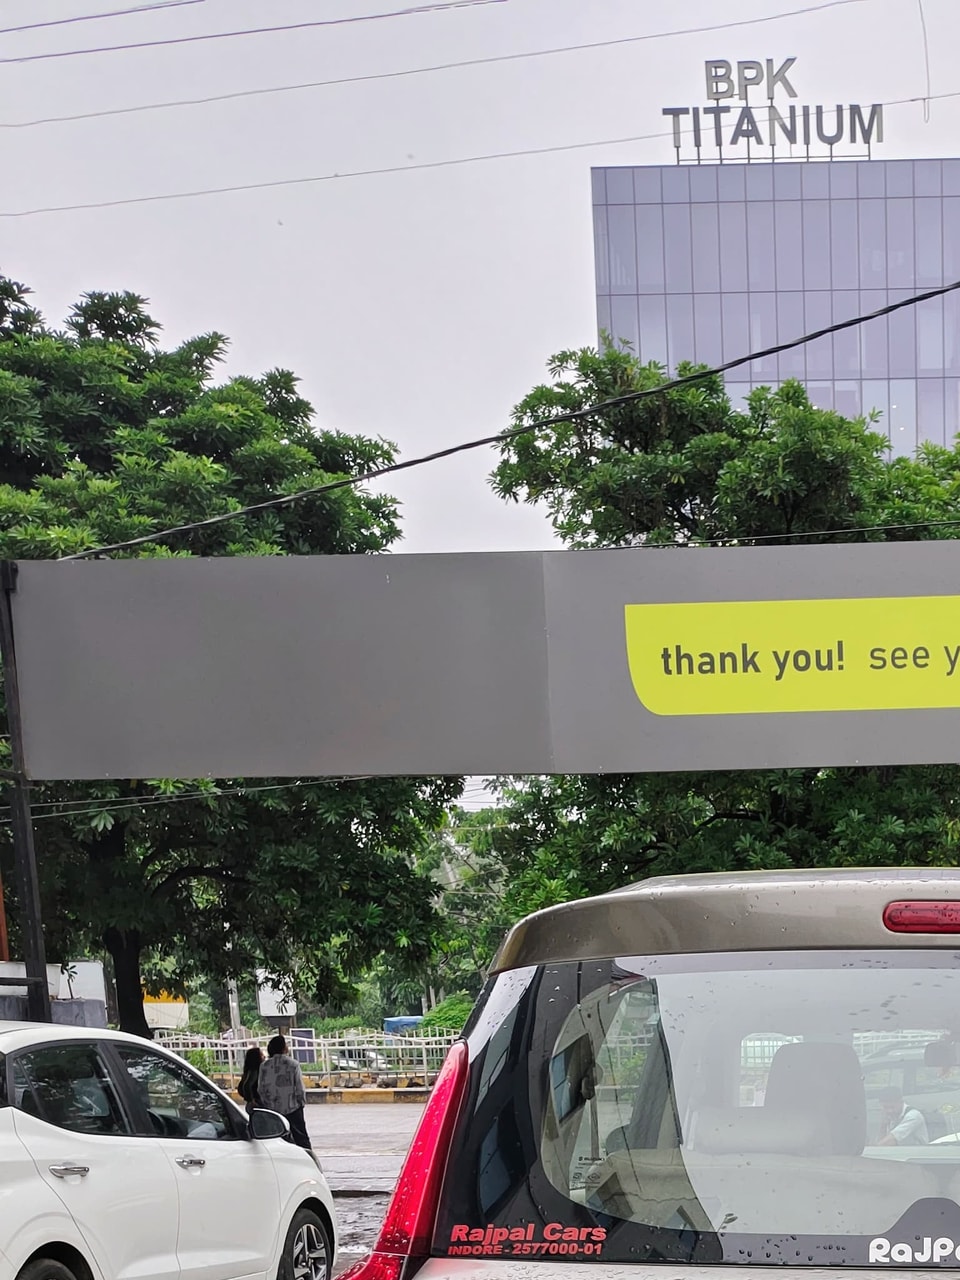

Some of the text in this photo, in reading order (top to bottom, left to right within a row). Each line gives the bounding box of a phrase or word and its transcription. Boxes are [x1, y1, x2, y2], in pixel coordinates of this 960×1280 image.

[704, 56, 798, 100] BPK
[661, 103, 884, 148] TITANIUM
[660, 642, 762, 676] thank
[771, 640, 845, 682] you!
[868, 645, 931, 671] see
[448, 1245, 503, 1256] INDORE
[512, 1242, 603, 1256] 2577000-01
[450, 1222, 607, 1245] Rajpal Cars
